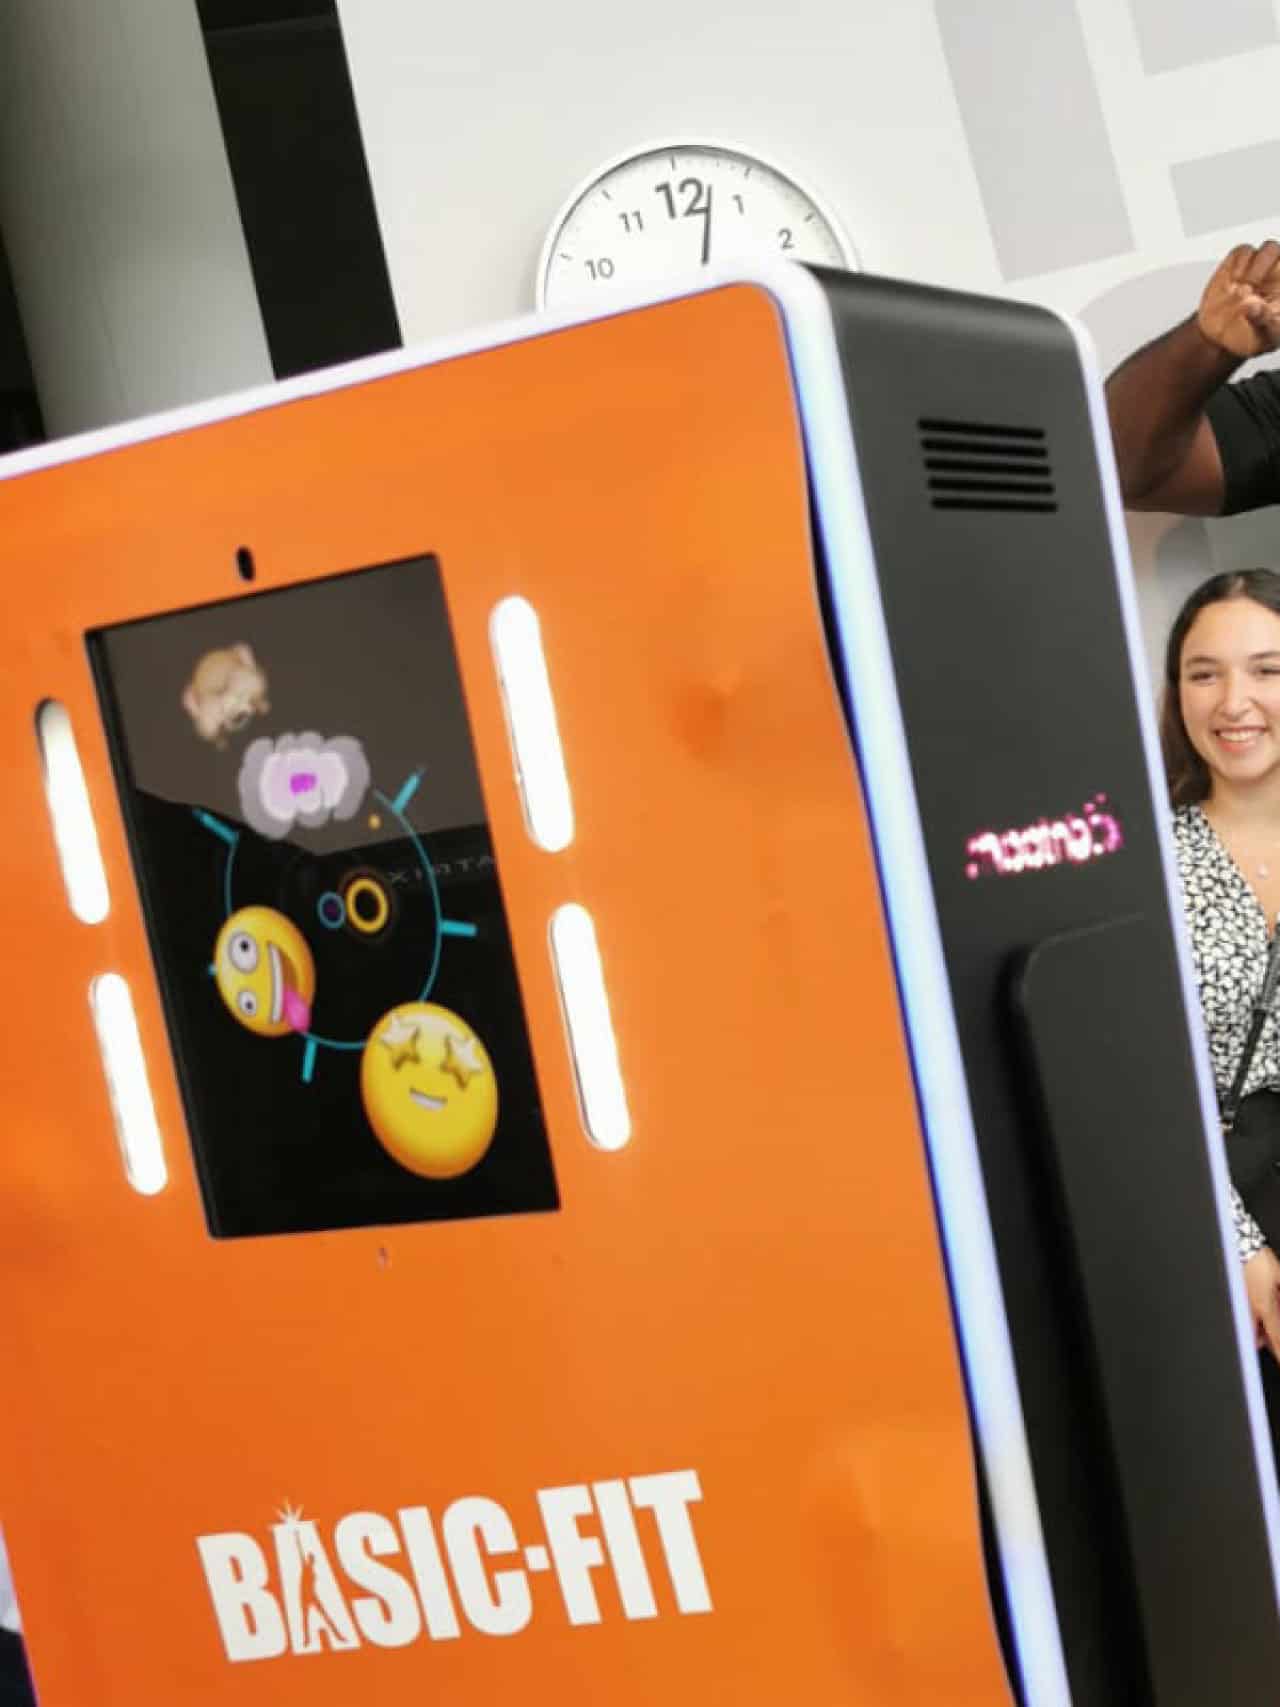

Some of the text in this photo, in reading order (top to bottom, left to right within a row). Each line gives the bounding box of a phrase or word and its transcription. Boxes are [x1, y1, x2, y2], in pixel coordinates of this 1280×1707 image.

[654, 177, 708, 219] 12
[733, 194, 745, 215] 1
[619, 210, 644, 232] 11
[778, 227, 793, 249] 2
[585, 258, 614, 280] 10
[196, 1469, 713, 1663] BASIC-FIT
